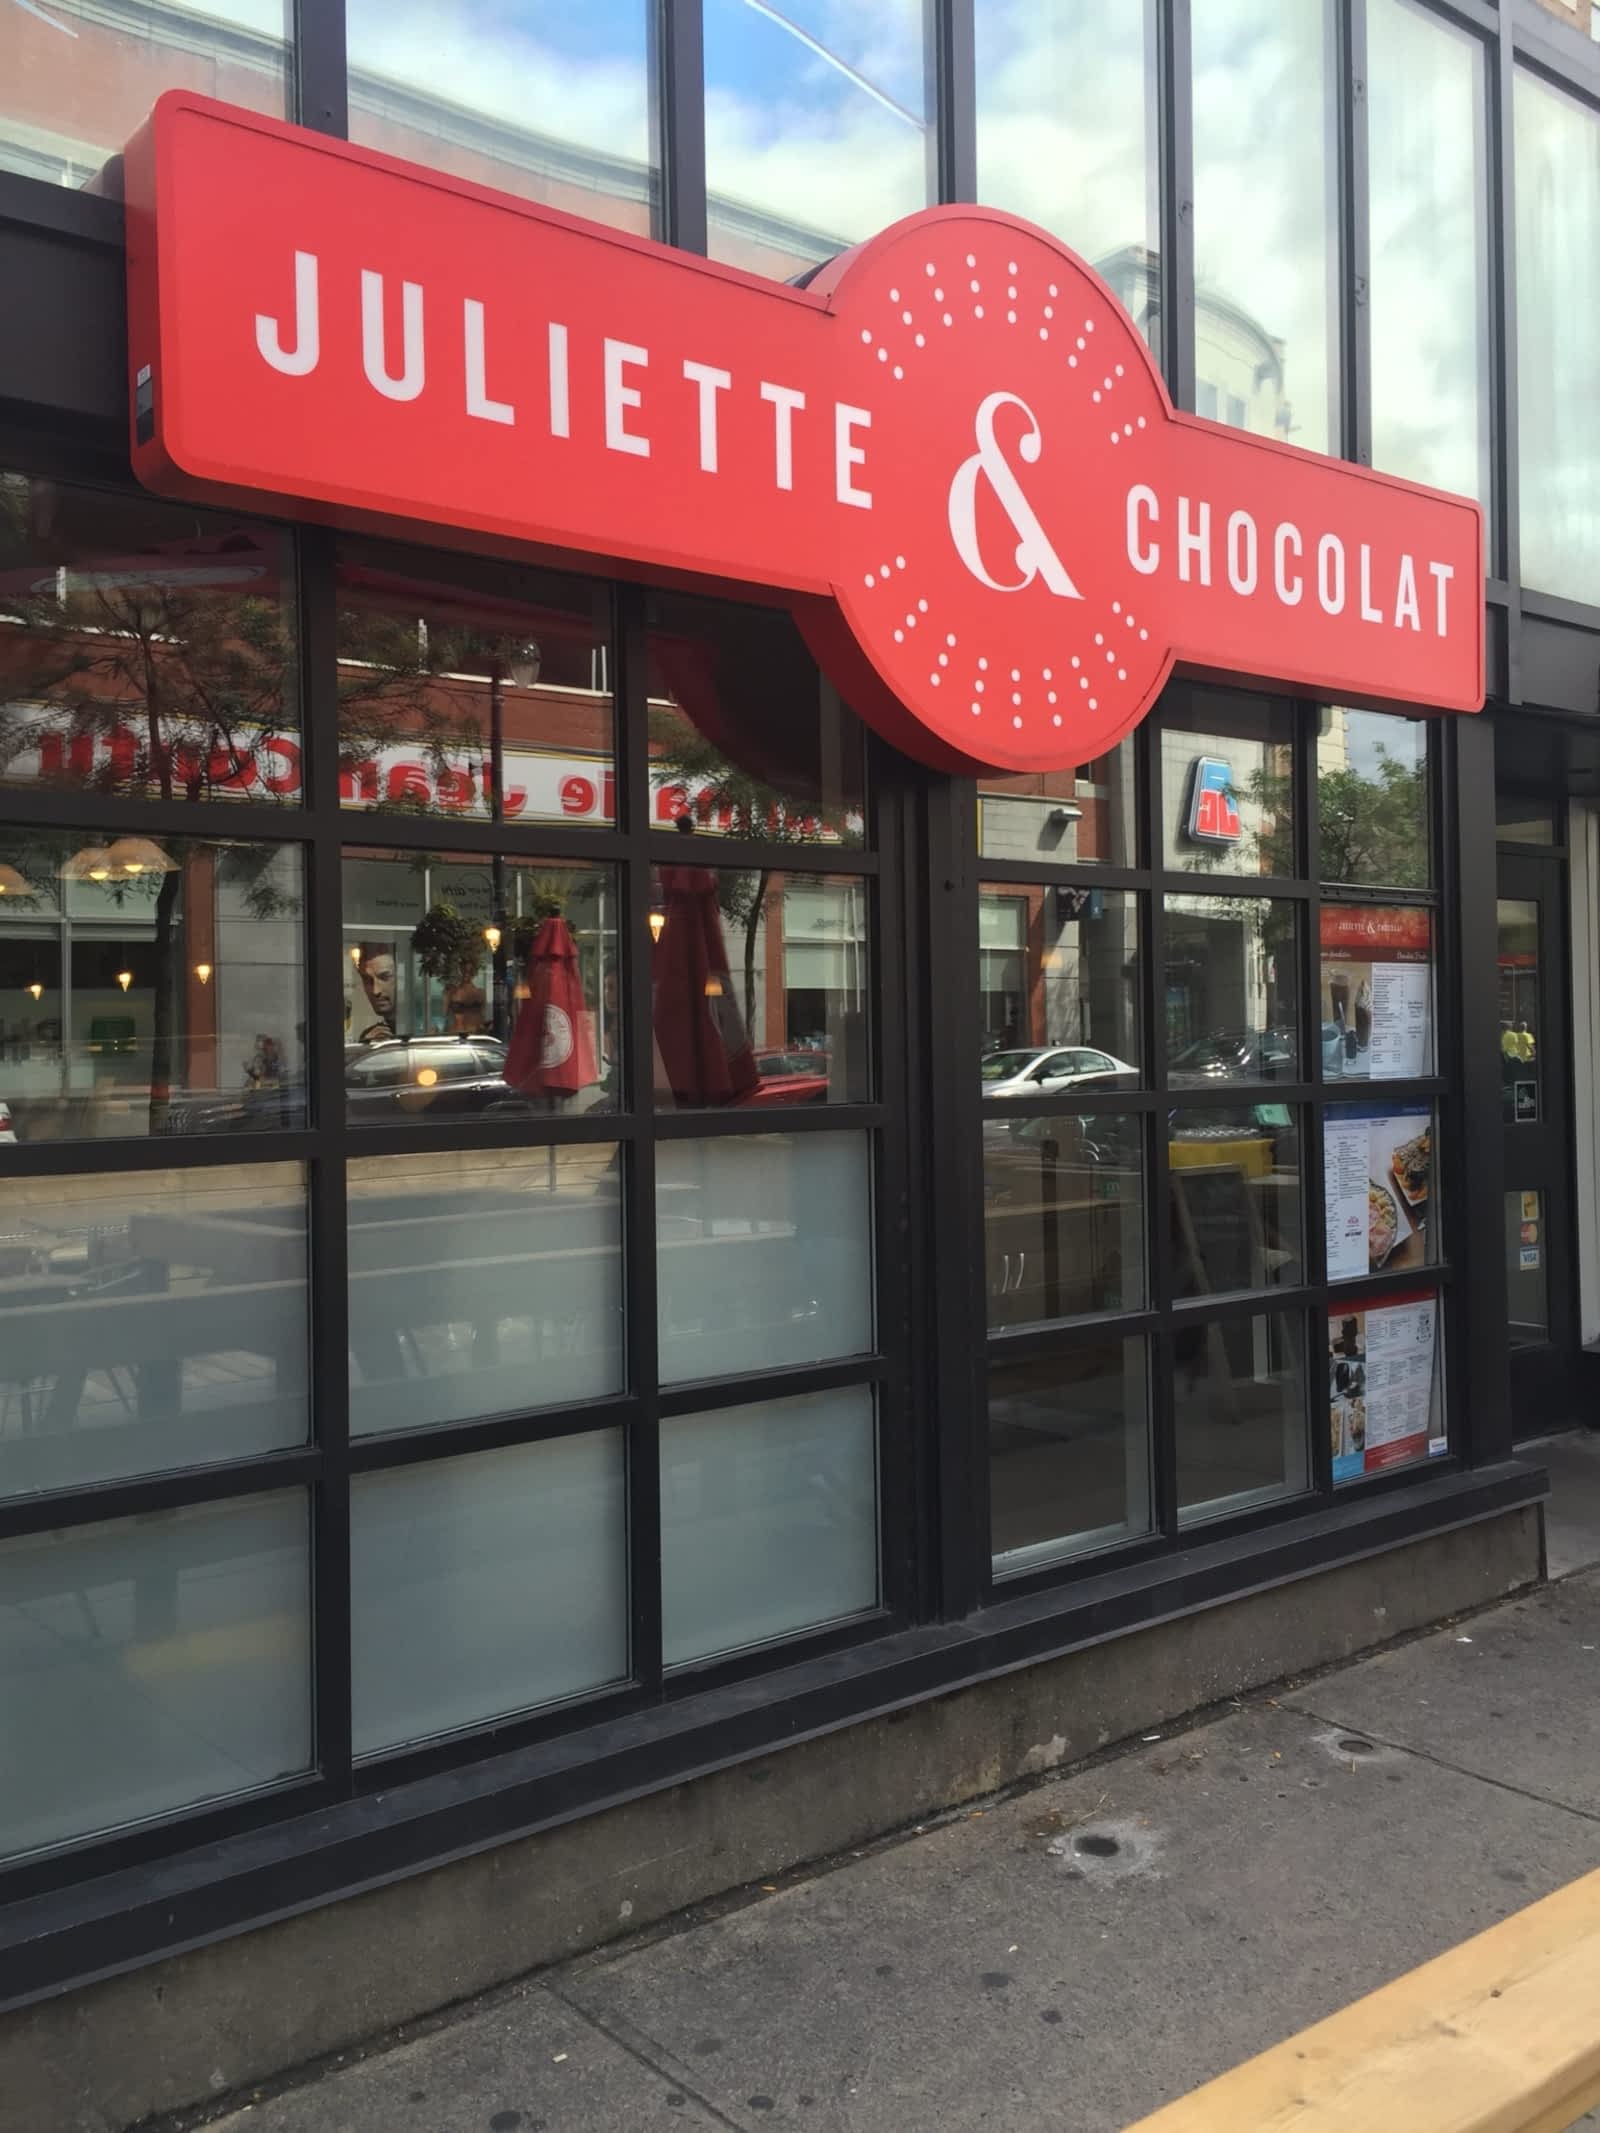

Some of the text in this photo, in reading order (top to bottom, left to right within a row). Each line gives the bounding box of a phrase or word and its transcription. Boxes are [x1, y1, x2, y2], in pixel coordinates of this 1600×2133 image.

[255, 250, 1454, 637] JULIETTE & CHOCOLAT
